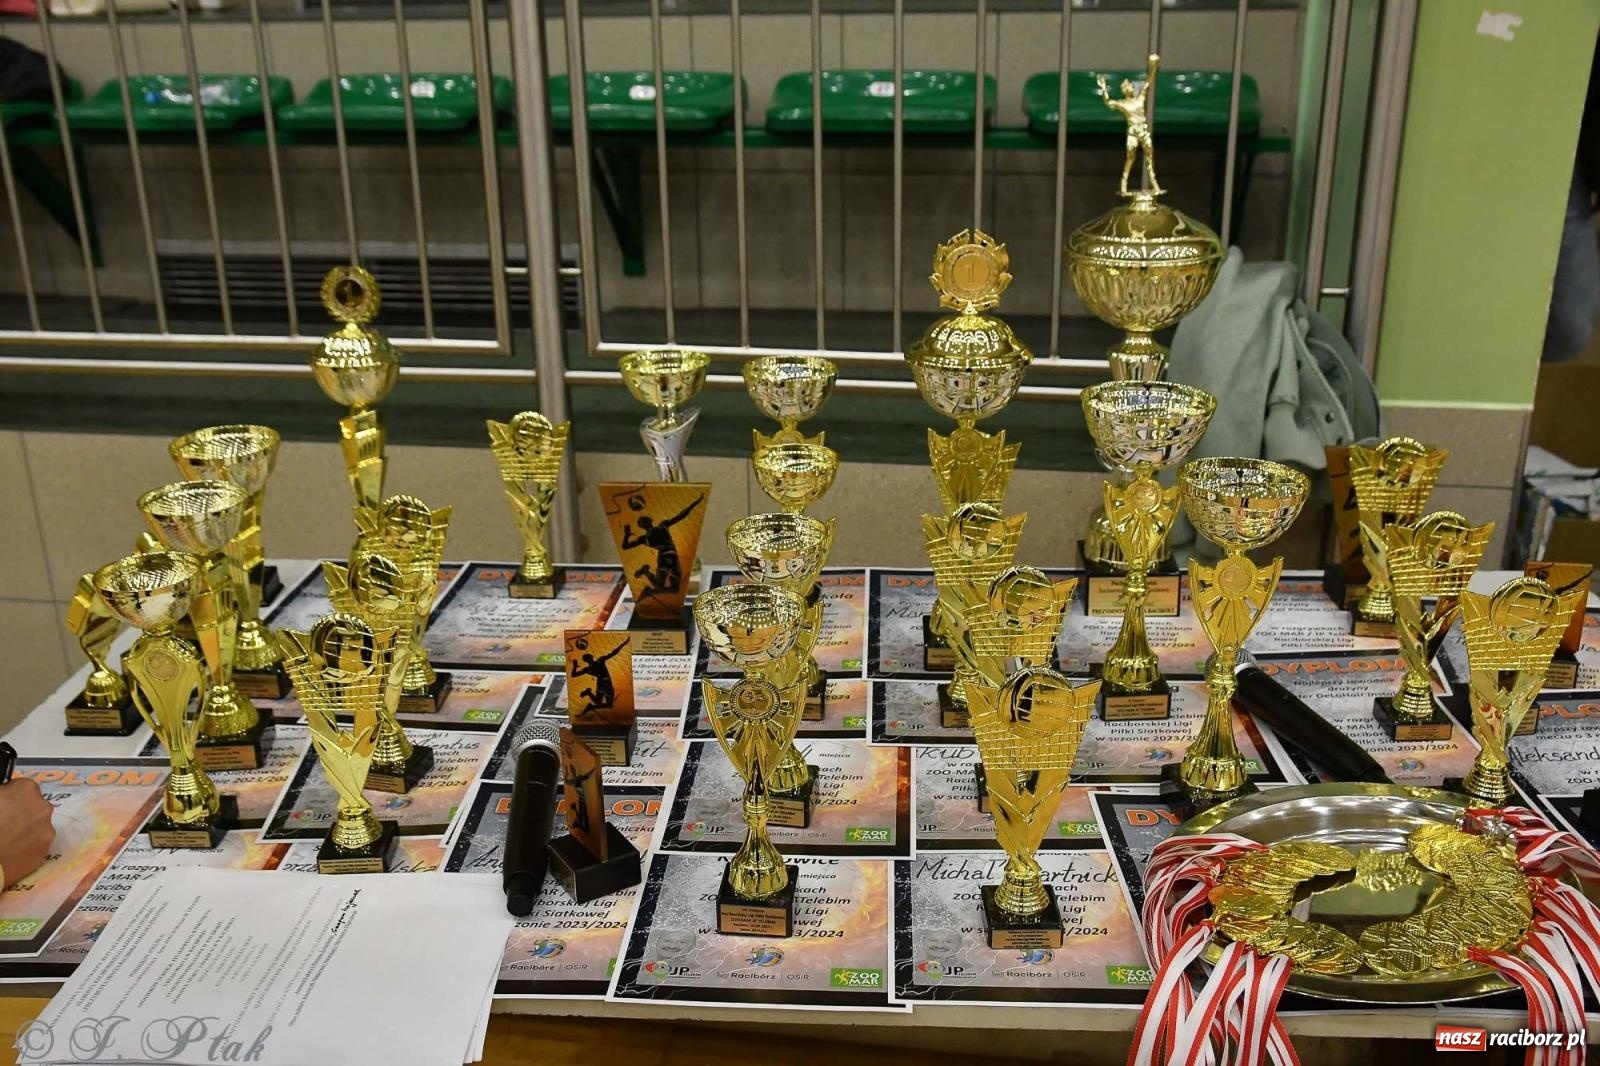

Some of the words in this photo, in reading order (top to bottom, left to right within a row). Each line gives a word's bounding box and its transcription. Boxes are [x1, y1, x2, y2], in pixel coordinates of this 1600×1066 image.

[1396, 744, 1459, 752] 2023/2024
[800, 872, 837, 880] miejsca
[593, 899, 618, 909] Ligi
[542, 909, 610, 919] Siatkowej
[804, 907, 830, 916] Ligi
[1062, 905, 1087, 914] Ligi
[514, 921, 551, 929] zonie
[553, 920, 628, 930] 2023/2024
[794, 929, 845, 938] 3/2024
[731, 972, 777, 980] Racibórz
